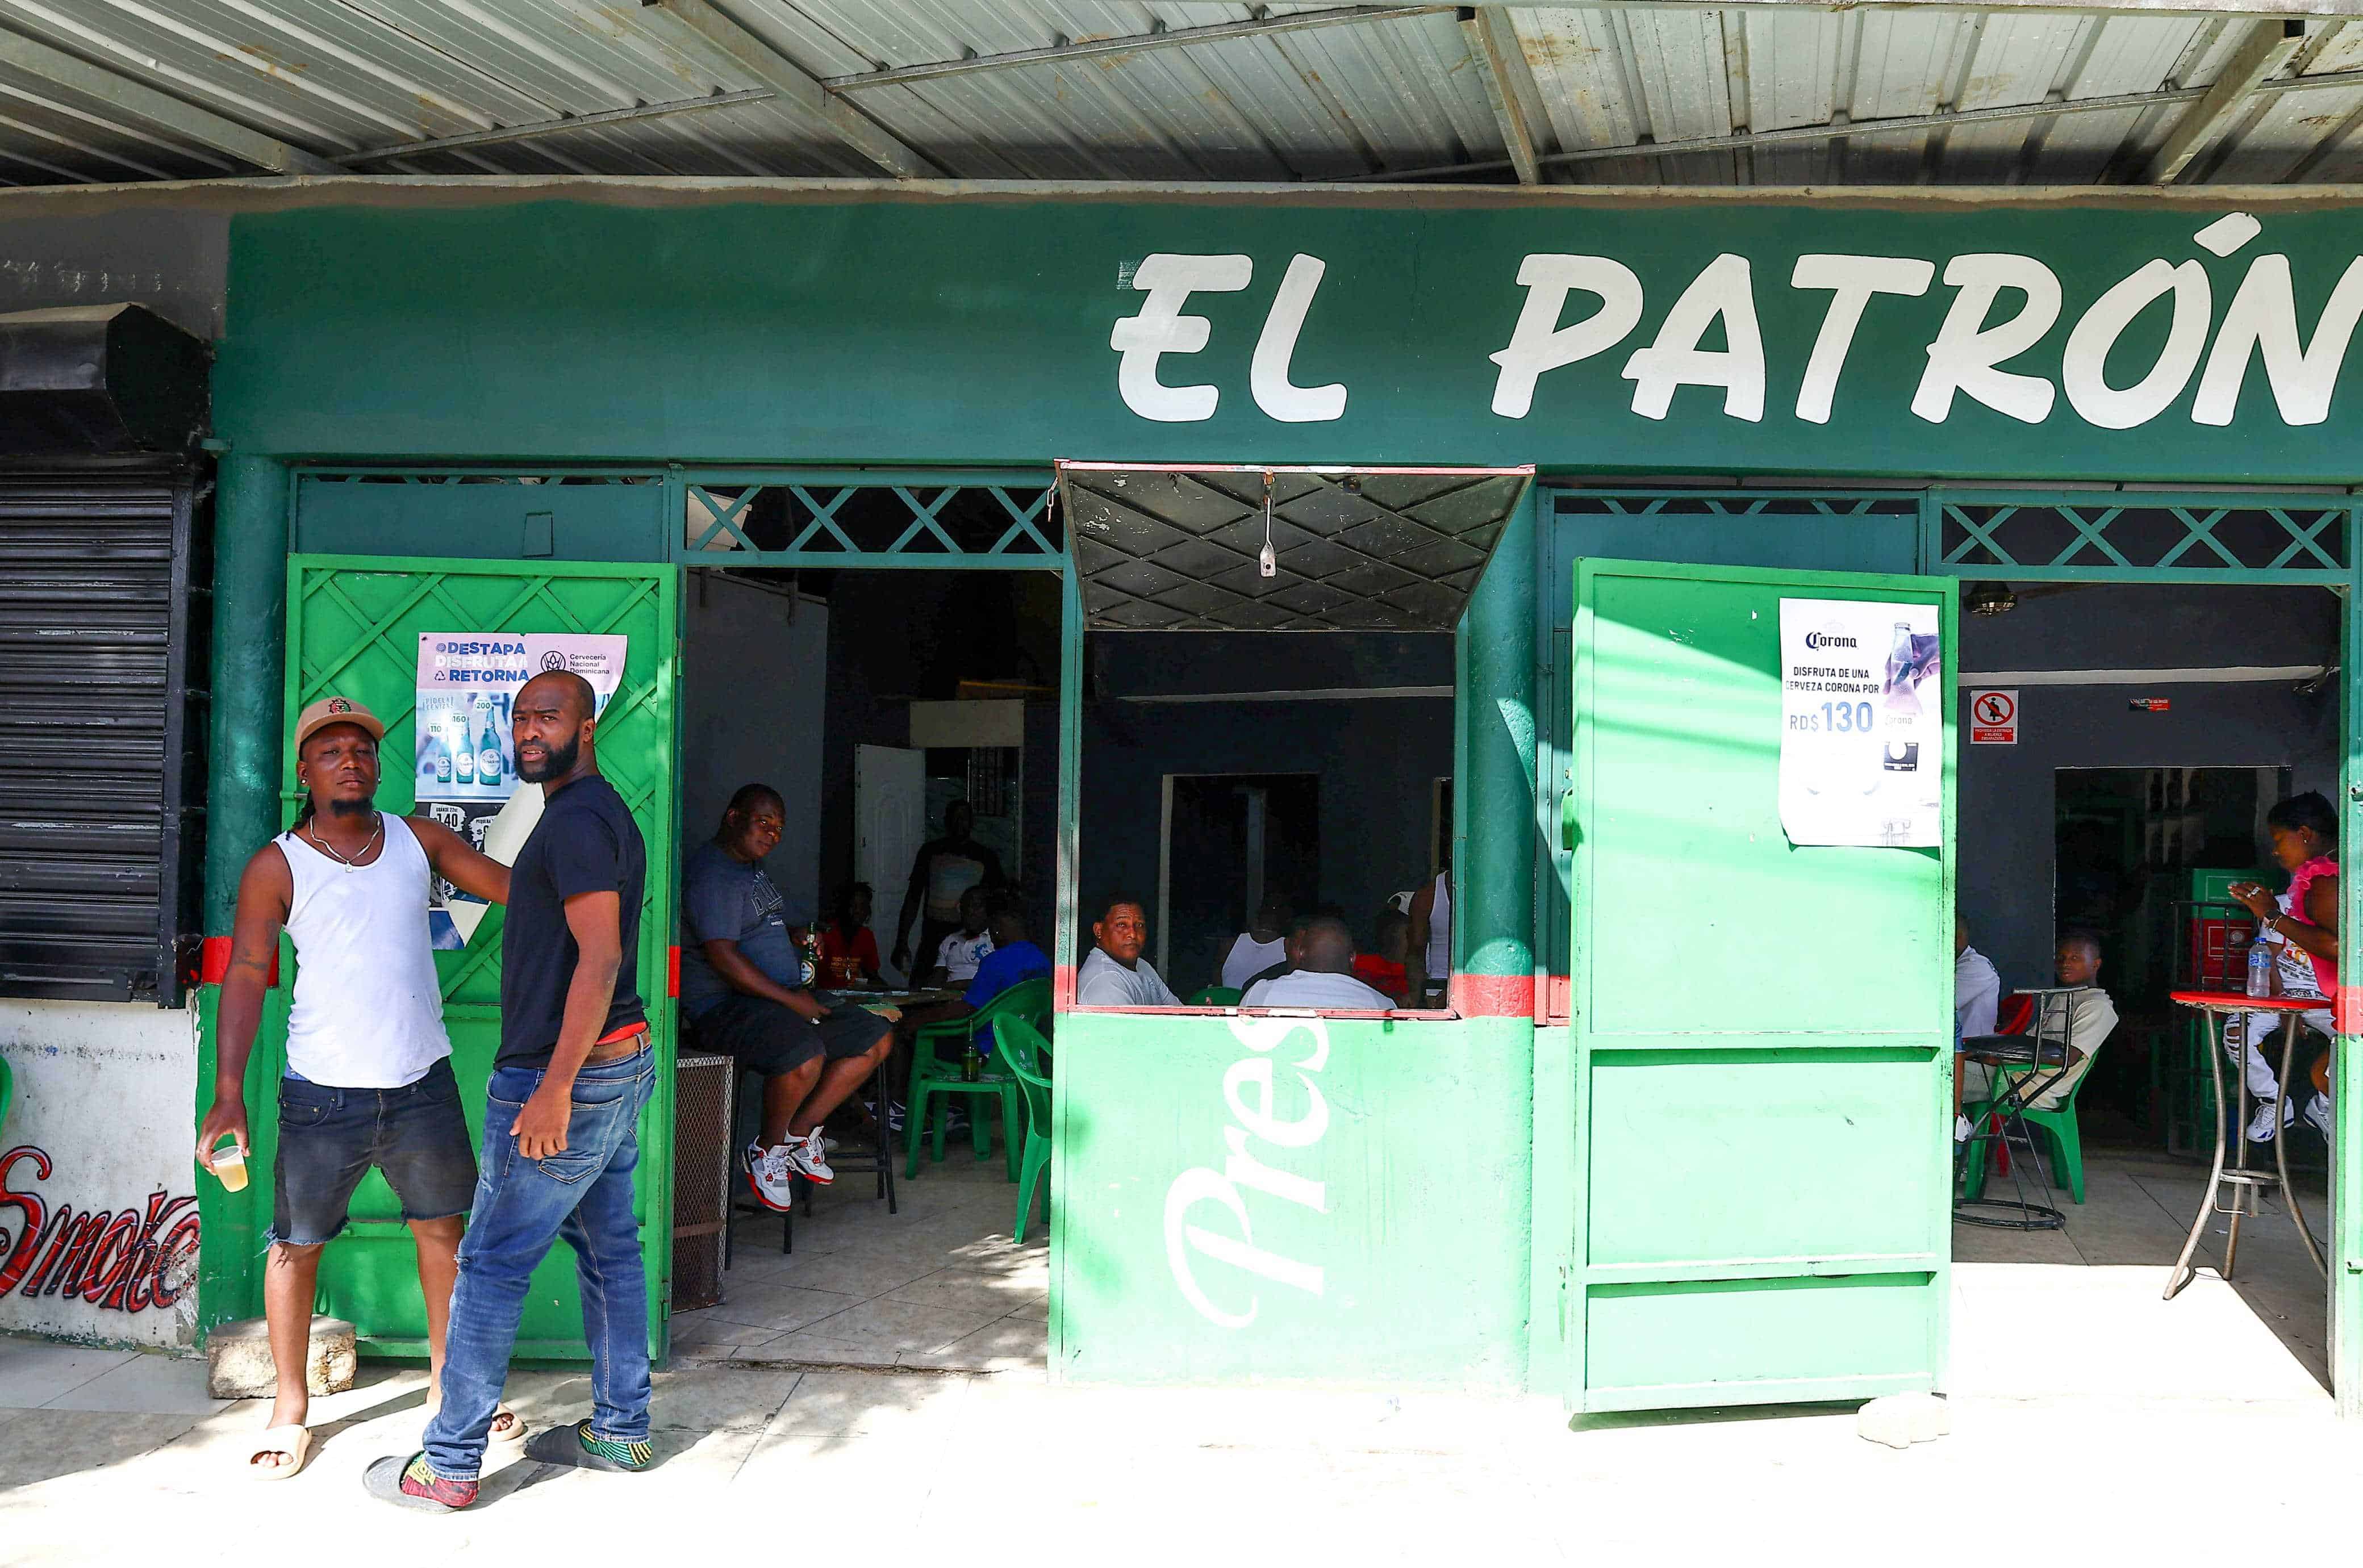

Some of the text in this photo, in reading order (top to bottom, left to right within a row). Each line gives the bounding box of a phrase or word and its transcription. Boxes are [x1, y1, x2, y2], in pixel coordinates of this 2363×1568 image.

[1110, 212, 2363, 429] EL PATRÓN
[448, 642, 525, 655] DESTAPA
[1805, 632, 1859, 651] Corona
[435, 655, 519, 668] DISFRUTA
[449, 669, 529, 682] RETORNA
[1794, 667, 1869, 679] DISFRUTA DE UNA
[1786, 680, 1880, 693] CERVEZA CORONA POR
[1790, 701, 1873, 733] RD$ 130
[436, 813, 458, 827] 140
[1164, 1015, 1330, 1328] Pres
[0, 1145, 199, 1313] Smoke
